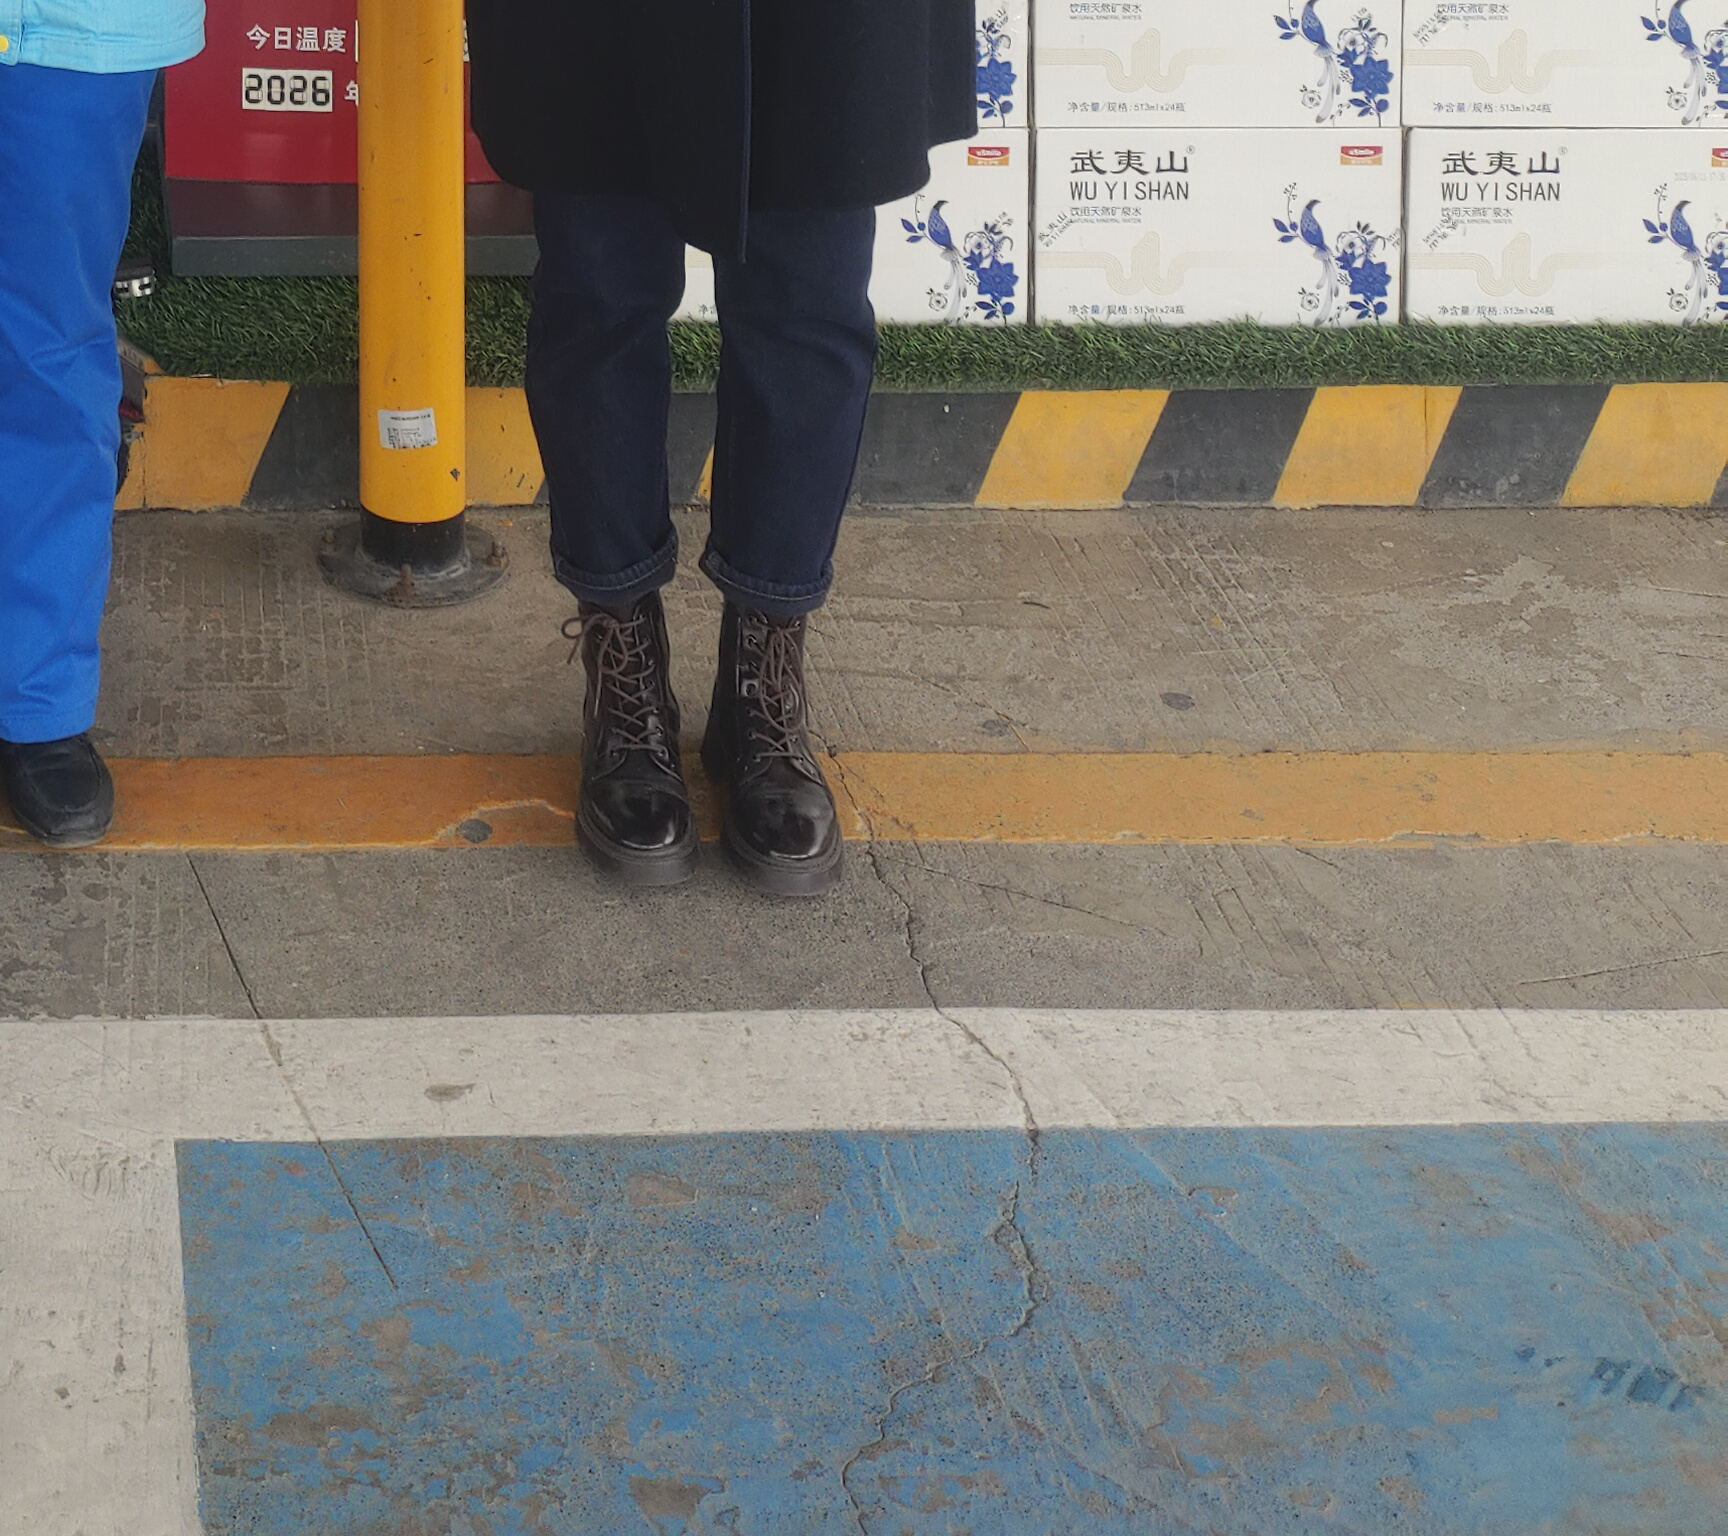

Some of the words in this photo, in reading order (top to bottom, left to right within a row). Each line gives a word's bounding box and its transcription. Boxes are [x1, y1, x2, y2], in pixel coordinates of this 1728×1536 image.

[246, 25, 347, 53] 今日温度
[245, 74, 331, 104] 2026
[1069, 148, 1190, 176] 武夷山
[1441, 150, 1561, 177] 武夷山
[1069, 181, 1097, 201] WU
[1134, 180, 1189, 201] SHAN
[1440, 182, 1469, 202] WU
[1505, 181, 1561, 202] SHAN
